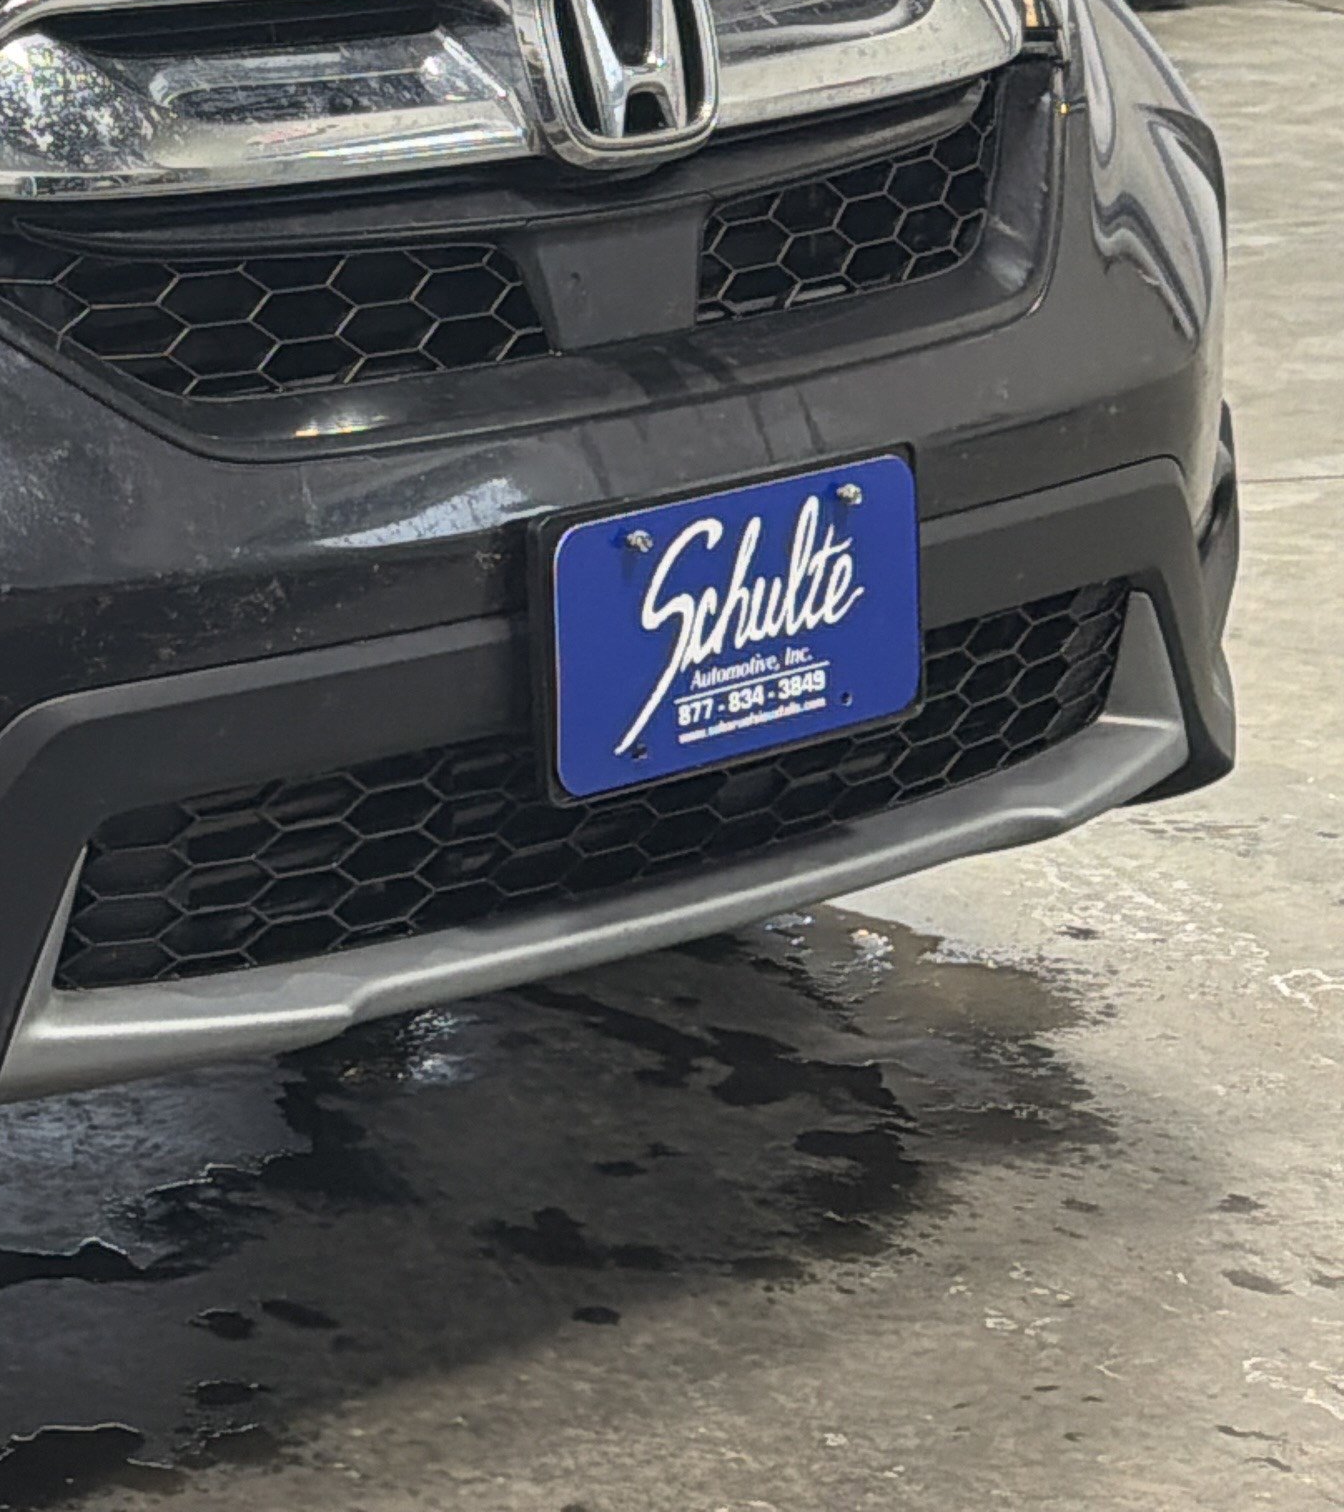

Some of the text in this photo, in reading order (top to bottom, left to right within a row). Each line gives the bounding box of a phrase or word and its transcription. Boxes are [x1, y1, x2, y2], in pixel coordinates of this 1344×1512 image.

[614, 495, 866, 756] Schulte
[690, 646, 814, 690] Automotive, Inc.
[677, 697, 714, 726] 877
[727, 684, 764, 713] 834
[777, 669, 827, 700] 3849
